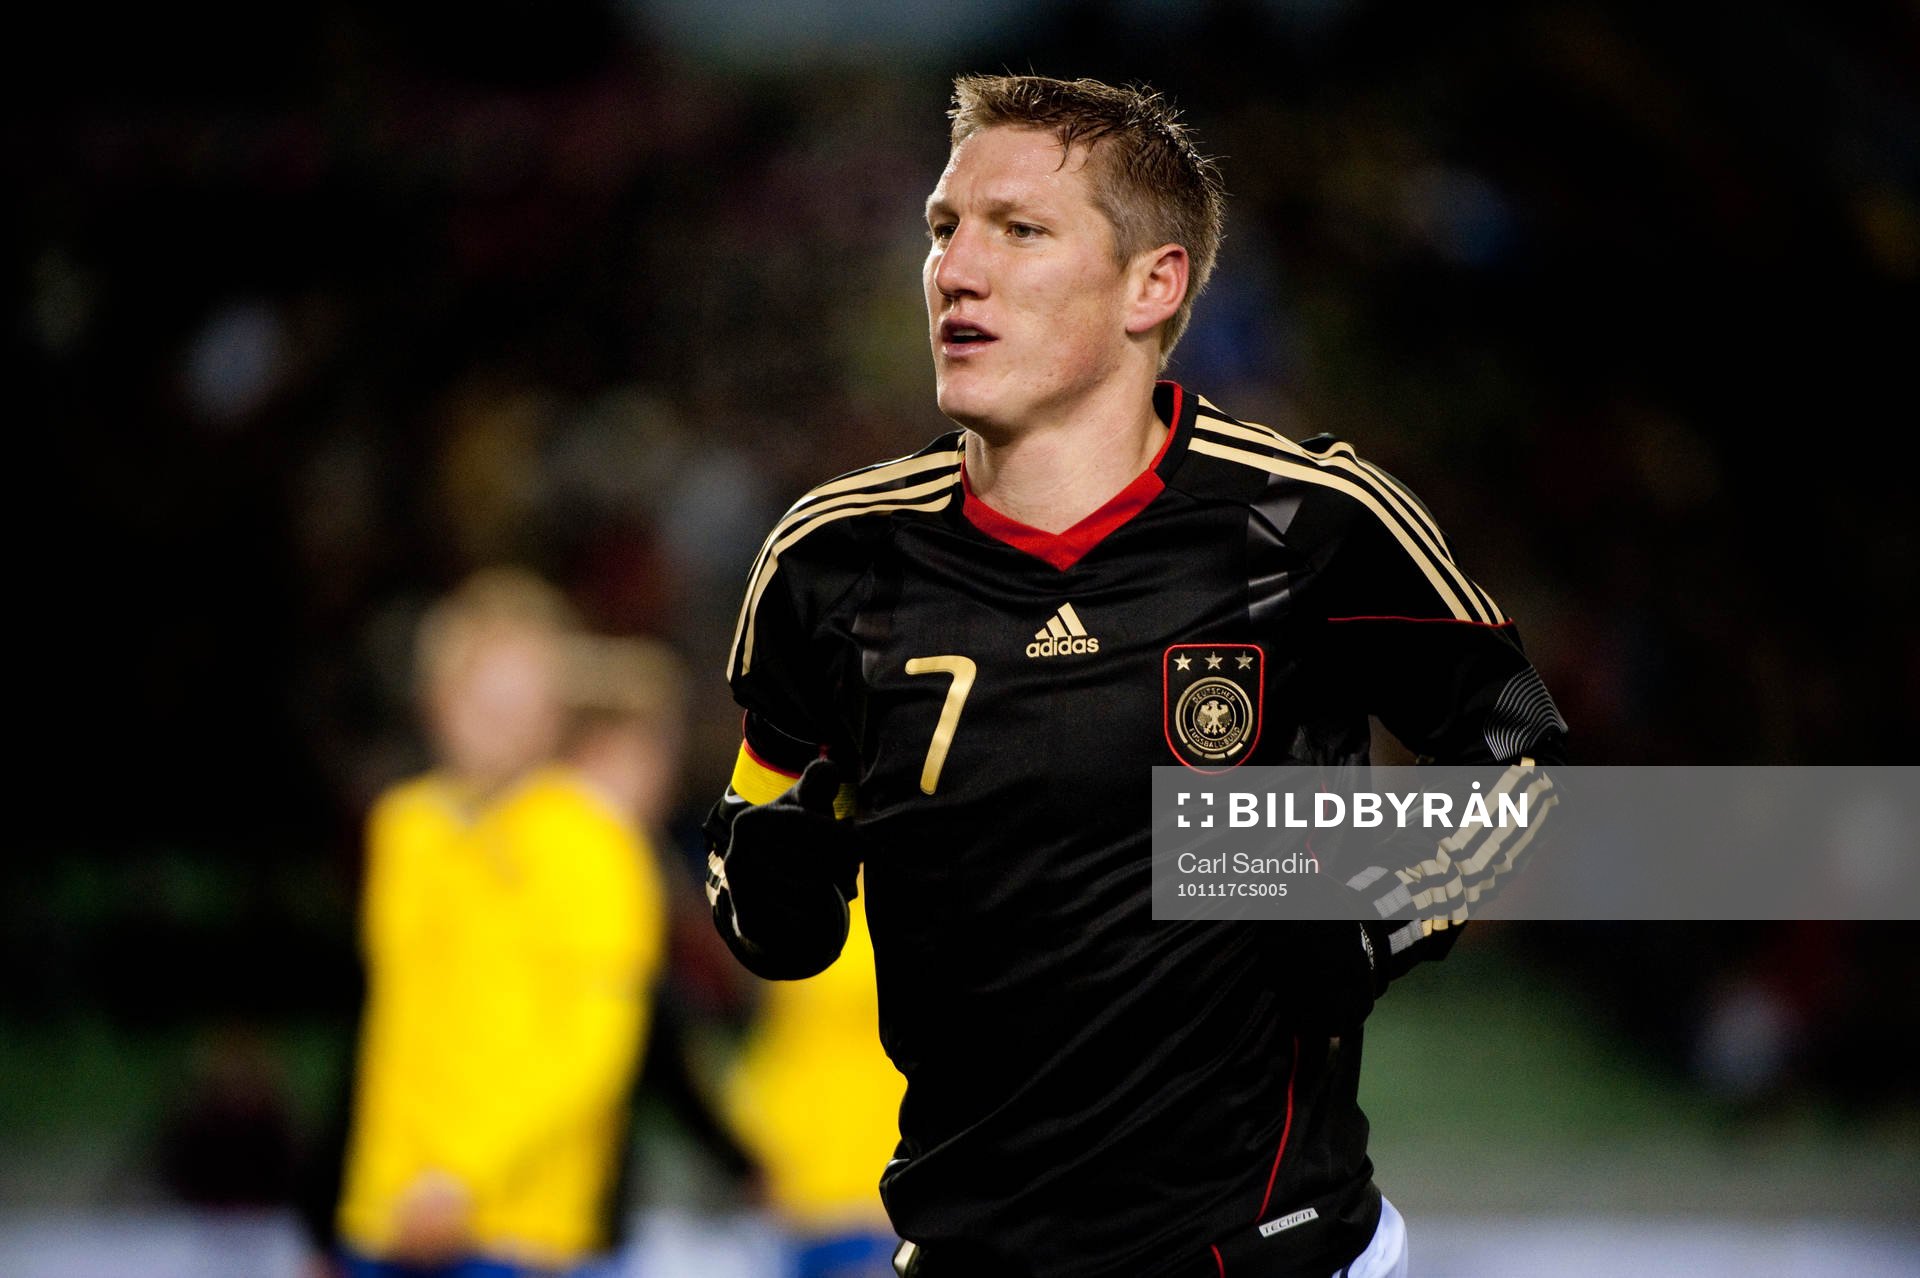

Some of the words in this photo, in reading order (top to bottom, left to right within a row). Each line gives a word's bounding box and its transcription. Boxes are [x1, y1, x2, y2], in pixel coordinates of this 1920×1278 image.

[1026, 635, 1099, 658] adidas
[1192, 688, 1235, 703] DEUTSCHER
[904, 655, 977, 796] 7
[1264, 1211, 1313, 1233] TECHFIT
